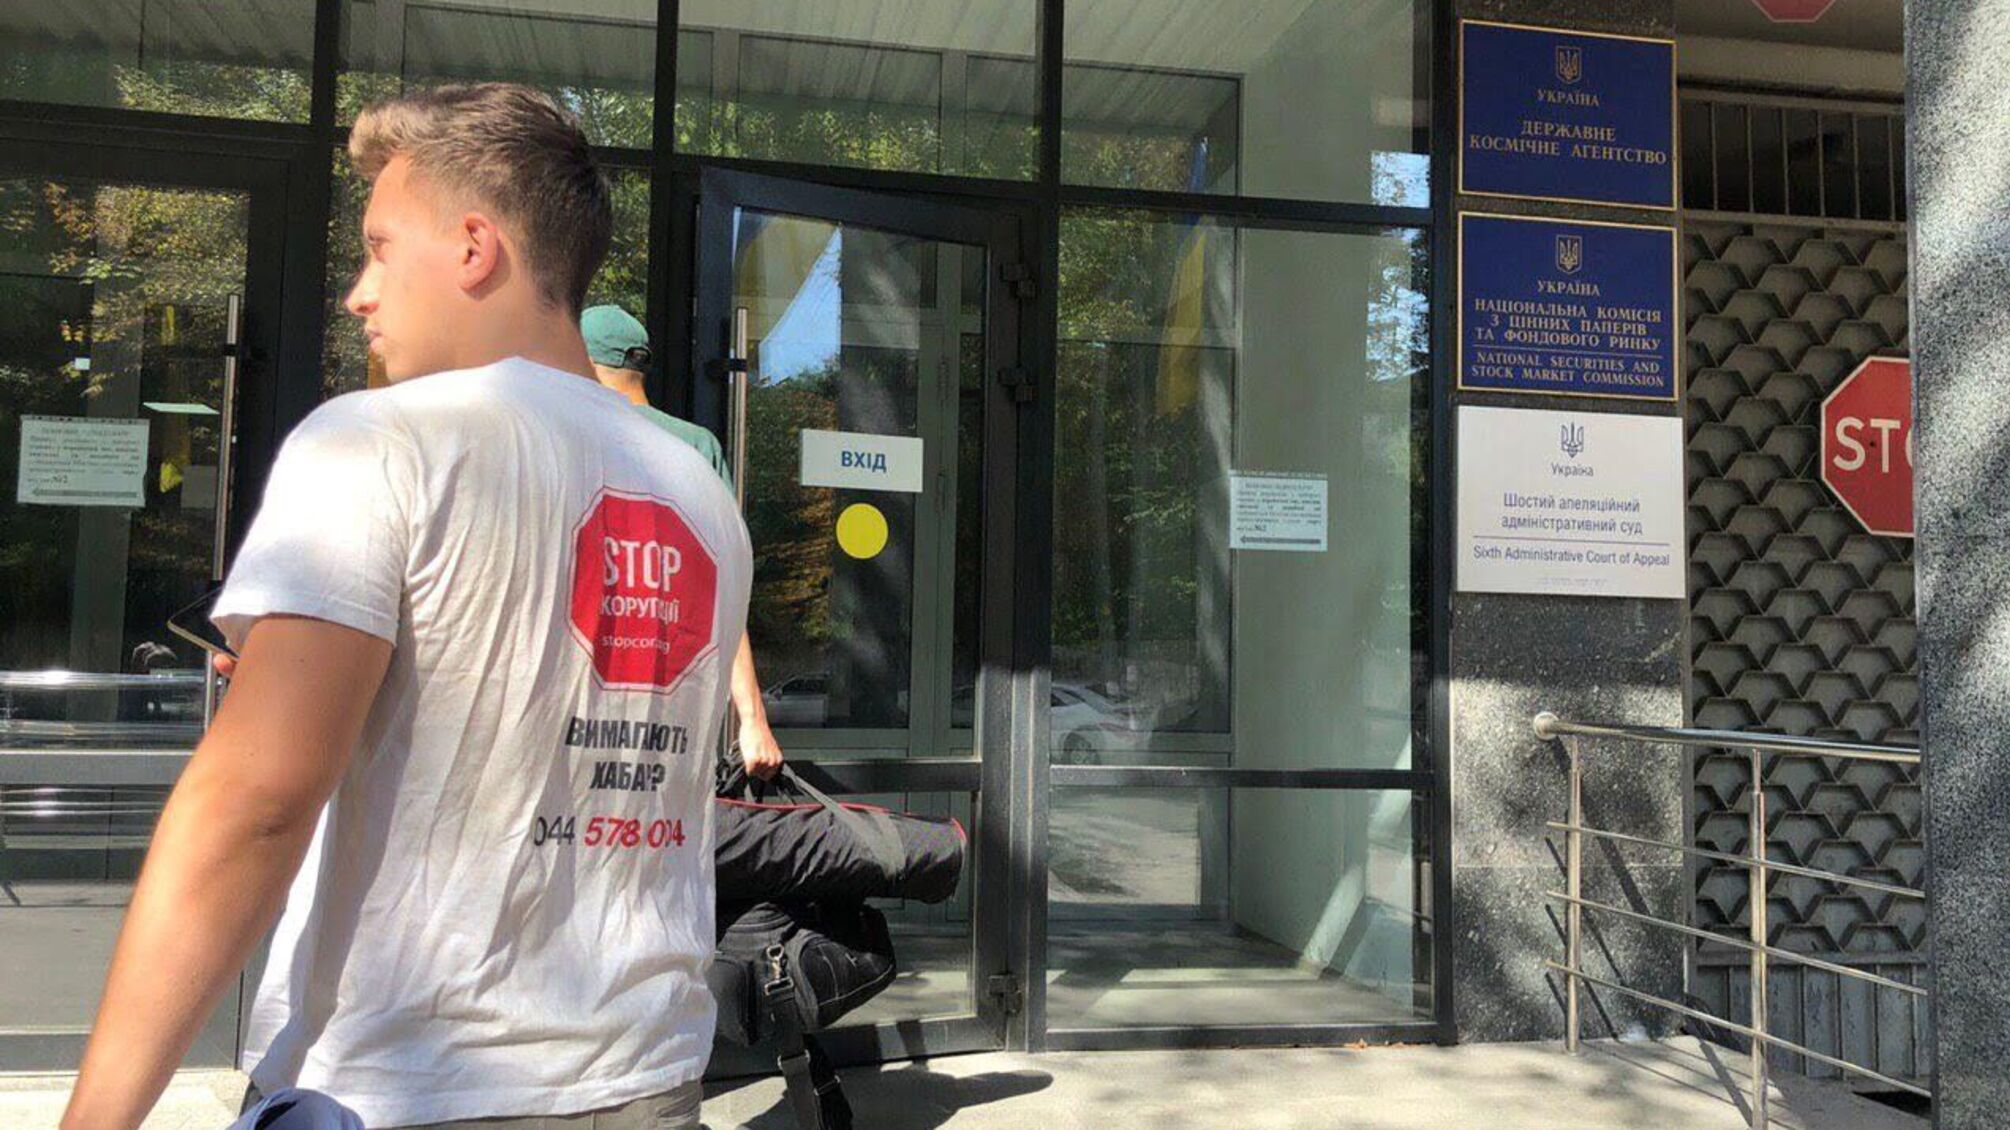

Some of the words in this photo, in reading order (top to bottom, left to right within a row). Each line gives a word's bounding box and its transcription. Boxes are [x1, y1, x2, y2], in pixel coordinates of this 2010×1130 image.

[1537, 89, 1600, 106] УКРАЇНА
[1520, 120, 1616, 142] ДЕРЖАВНЕ
[1469, 135, 1560, 156] КОСМІЧНЕ
[1571, 144, 1667, 164] АГЕНТСТВО
[1537, 280, 1601, 297] УКРАЇНА
[1475, 298, 1587, 318] НАЦІОНАЛЬНА
[1597, 306, 1662, 323] КОМІСІЯ
[1490, 315, 1500, 326] З
[1509, 315, 1570, 331] ЦІННИХ
[1580, 320, 1647, 336] ПАПЕРІВ
[1475, 327, 1495, 341] ТА
[1504, 330, 1600, 347] ФОНДОВОГО
[1609, 335, 1661, 350] РИНКУ
[1477, 352, 1542, 367] NATIONAL
[1550, 356, 1624, 372] SECURITIES
[1632, 360, 1660, 373] AND
[1472, 366, 1514, 379] STOCK
[1521, 368, 1575, 382] MARKET
[1583, 371, 1665, 387] COMMISSION
[1833, 416, 1913, 473] ST
[841, 450, 887, 473] ВХІД
[1551, 463, 1594, 478] Україна
[1503, 493, 1555, 509] Шостий
[1559, 497, 1640, 513] апеляційний
[1501, 514, 1616, 533] адміністративний
[1620, 523, 1643, 536] суд
[603, 536, 682, 592] STOP
[1473, 545, 1501, 559] Sixth
[1505, 547, 1583, 563] Administrative
[1586, 550, 1616, 564] Court
[1619, 551, 1630, 564] of
[1633, 552, 1670, 567] Appeal
[533, 815, 576, 847] 044
[584, 816, 641, 848] 578
